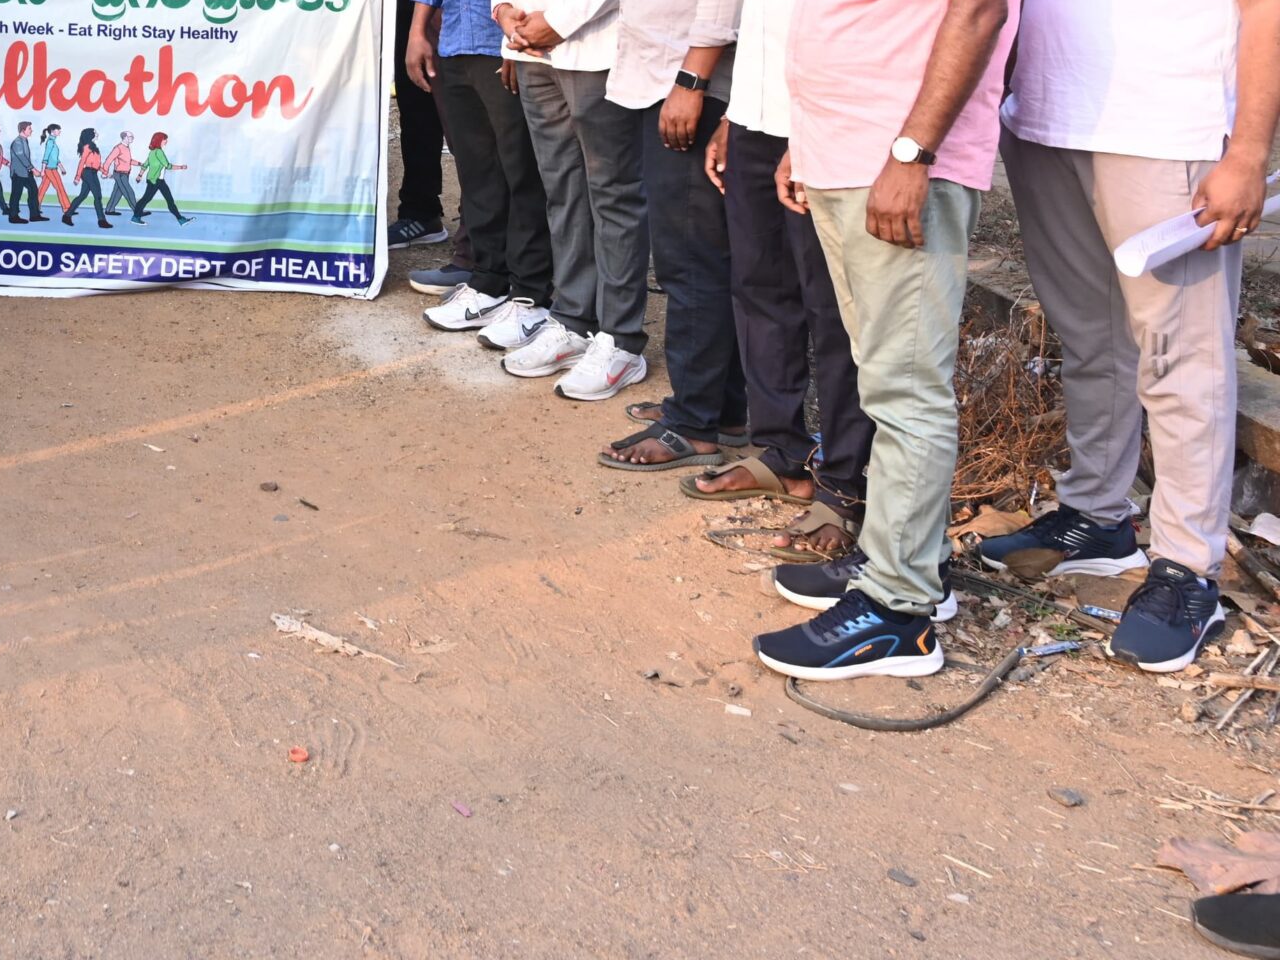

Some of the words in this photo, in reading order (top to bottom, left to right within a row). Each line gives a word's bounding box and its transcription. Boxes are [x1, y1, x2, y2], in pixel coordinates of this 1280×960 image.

[12, 21, 55, 36] Week
[68, 23, 93, 37] Eat
[96, 24, 138, 41] Right
[141, 25, 176, 42] Stay
[180, 26, 238, 43] Healthy
[59, 252, 156, 277] SAFETY
[160, 256, 226, 278] DEPT
[231, 257, 264, 277] OF
